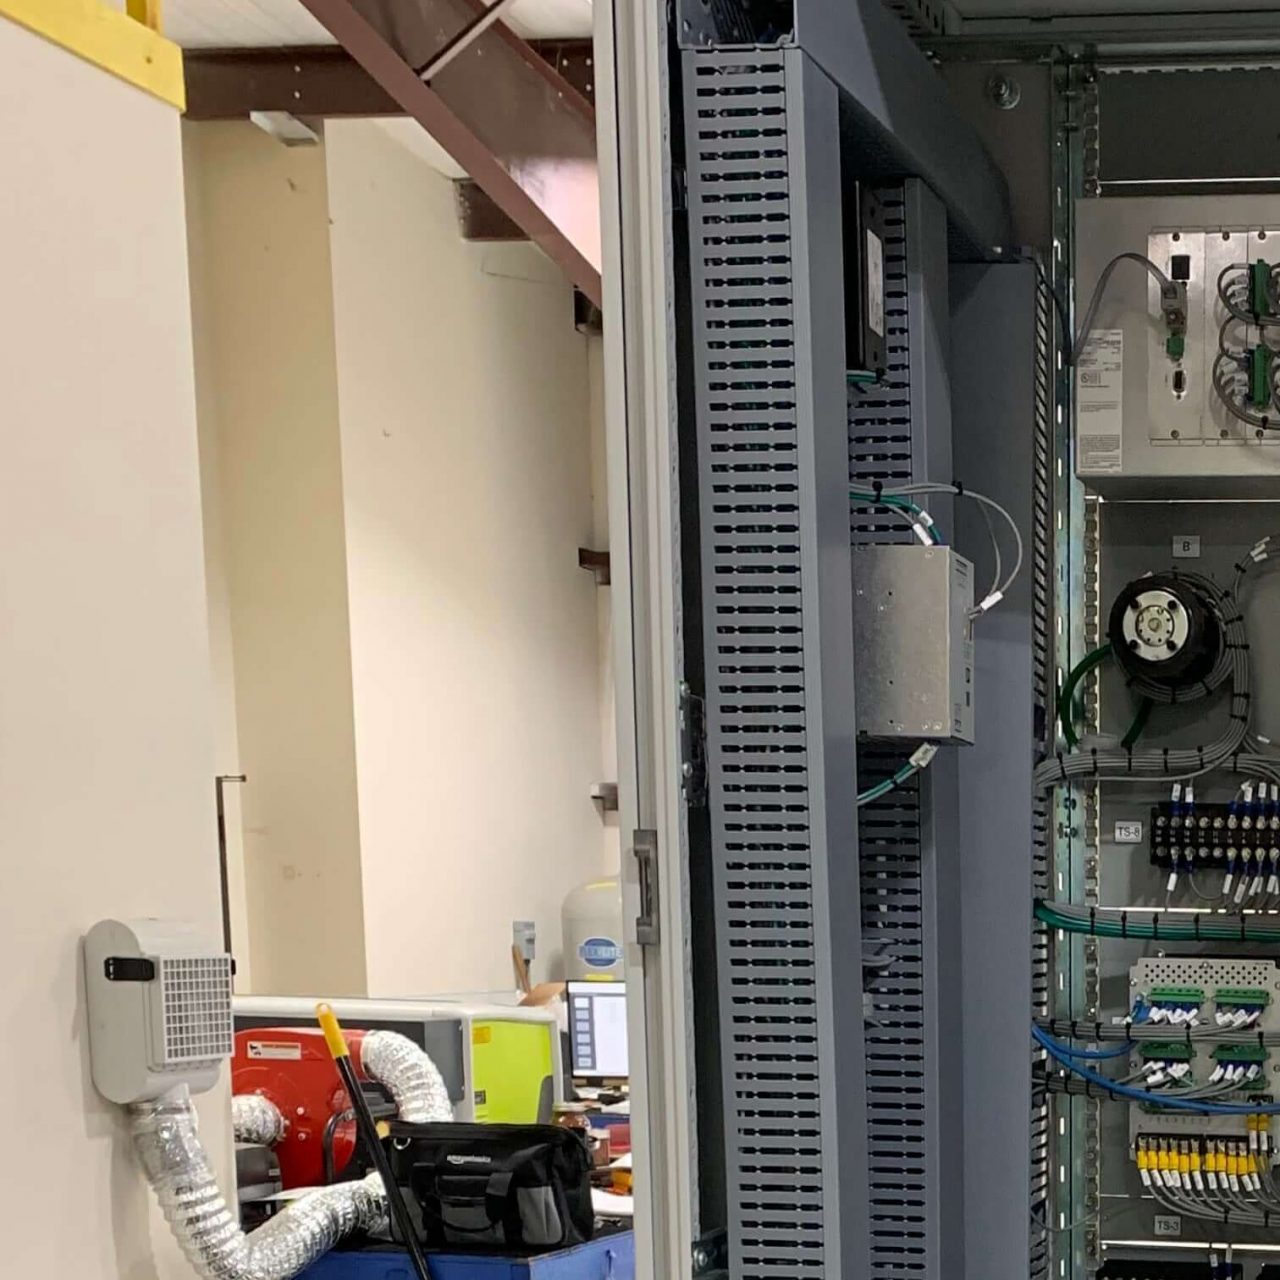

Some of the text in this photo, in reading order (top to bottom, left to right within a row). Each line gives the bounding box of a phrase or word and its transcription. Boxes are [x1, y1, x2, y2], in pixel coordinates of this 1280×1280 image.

[1182, 540, 1191, 552] B
[1118, 826, 1140, 838] TS-8
[1157, 1220, 1180, 1231] TS-3
